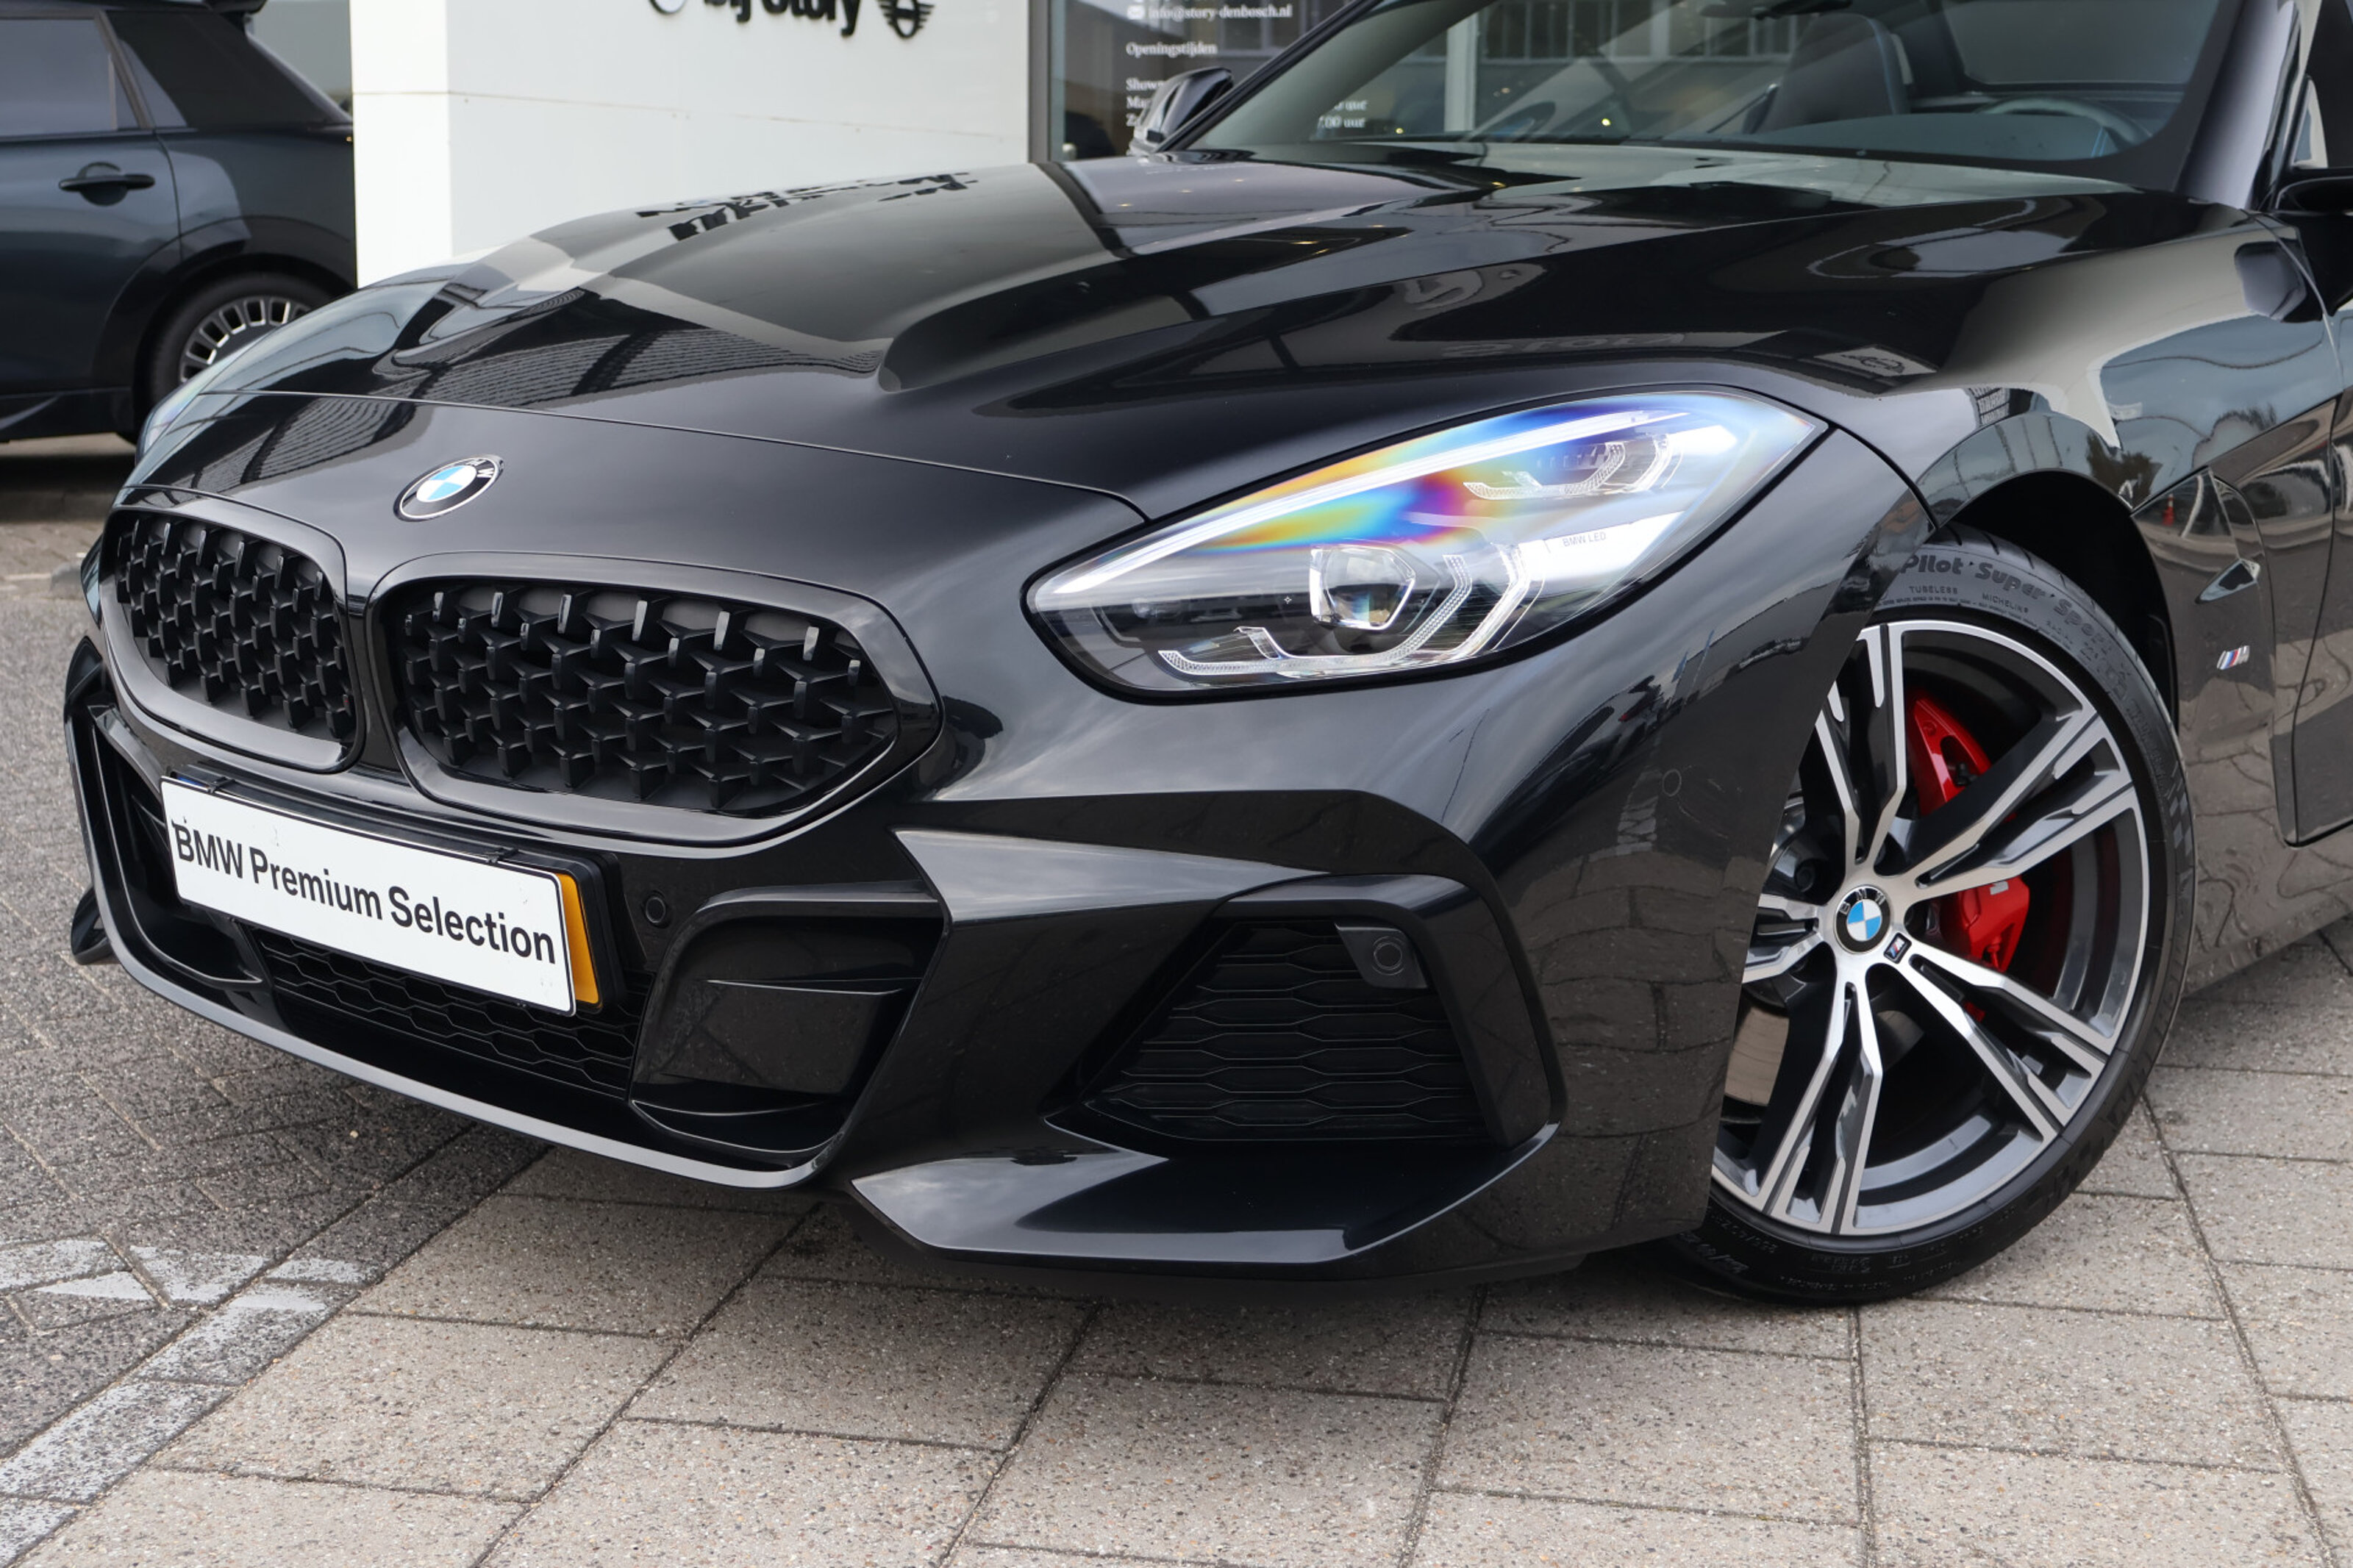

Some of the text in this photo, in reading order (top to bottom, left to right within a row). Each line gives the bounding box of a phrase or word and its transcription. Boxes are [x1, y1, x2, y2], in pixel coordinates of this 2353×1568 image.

[1126, 40, 1218, 57] Openingstijden
[1563, 531, 1606, 546] BMW LED
[1900, 554, 1964, 575] Pilot
[1975, 562, 2046, 600] Super
[173, 823, 556, 964] BMW Premium Selection
